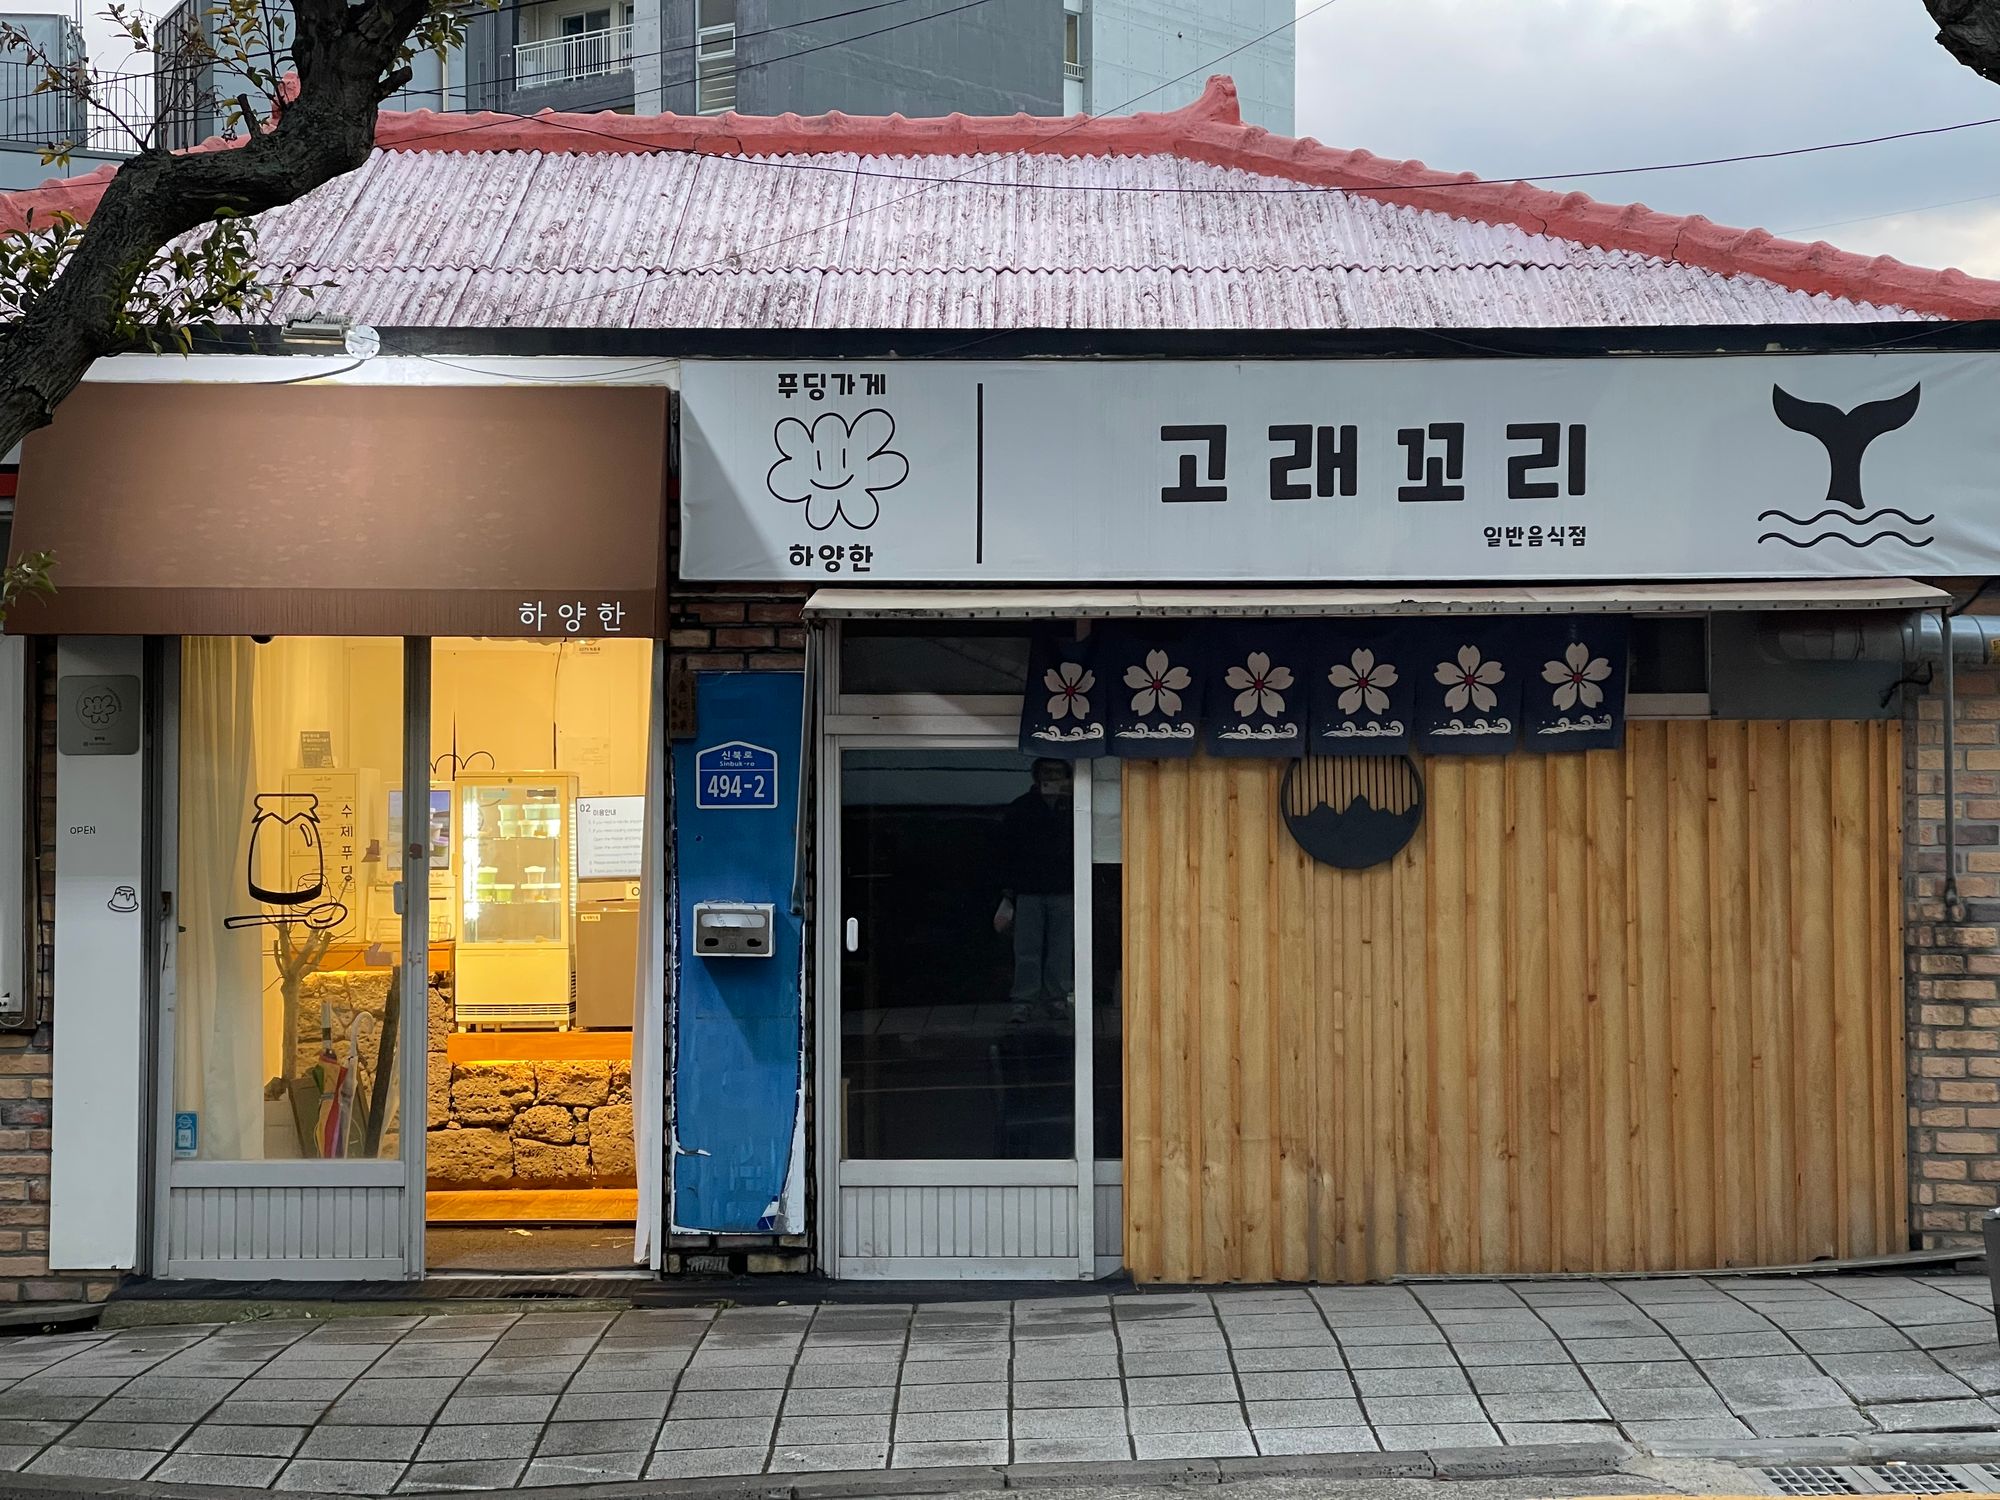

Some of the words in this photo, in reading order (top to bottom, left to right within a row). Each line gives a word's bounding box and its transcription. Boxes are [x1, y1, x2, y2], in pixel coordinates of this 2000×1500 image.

[777, 372, 887, 401] 푸딩가게
[1160, 422, 1587, 503] 고래꼬리
[1483, 525, 1587, 548] 일반음식점
[788, 543, 874, 573] 하양한
[518, 600, 626, 632] 하양한
[720, 750, 754, 761] 신북로
[707, 774, 765, 798] 494-2
[579, 803, 591, 813] 02
[69, 825, 96, 835] OPEN
[340, 803, 353, 882] 수제푸딩
